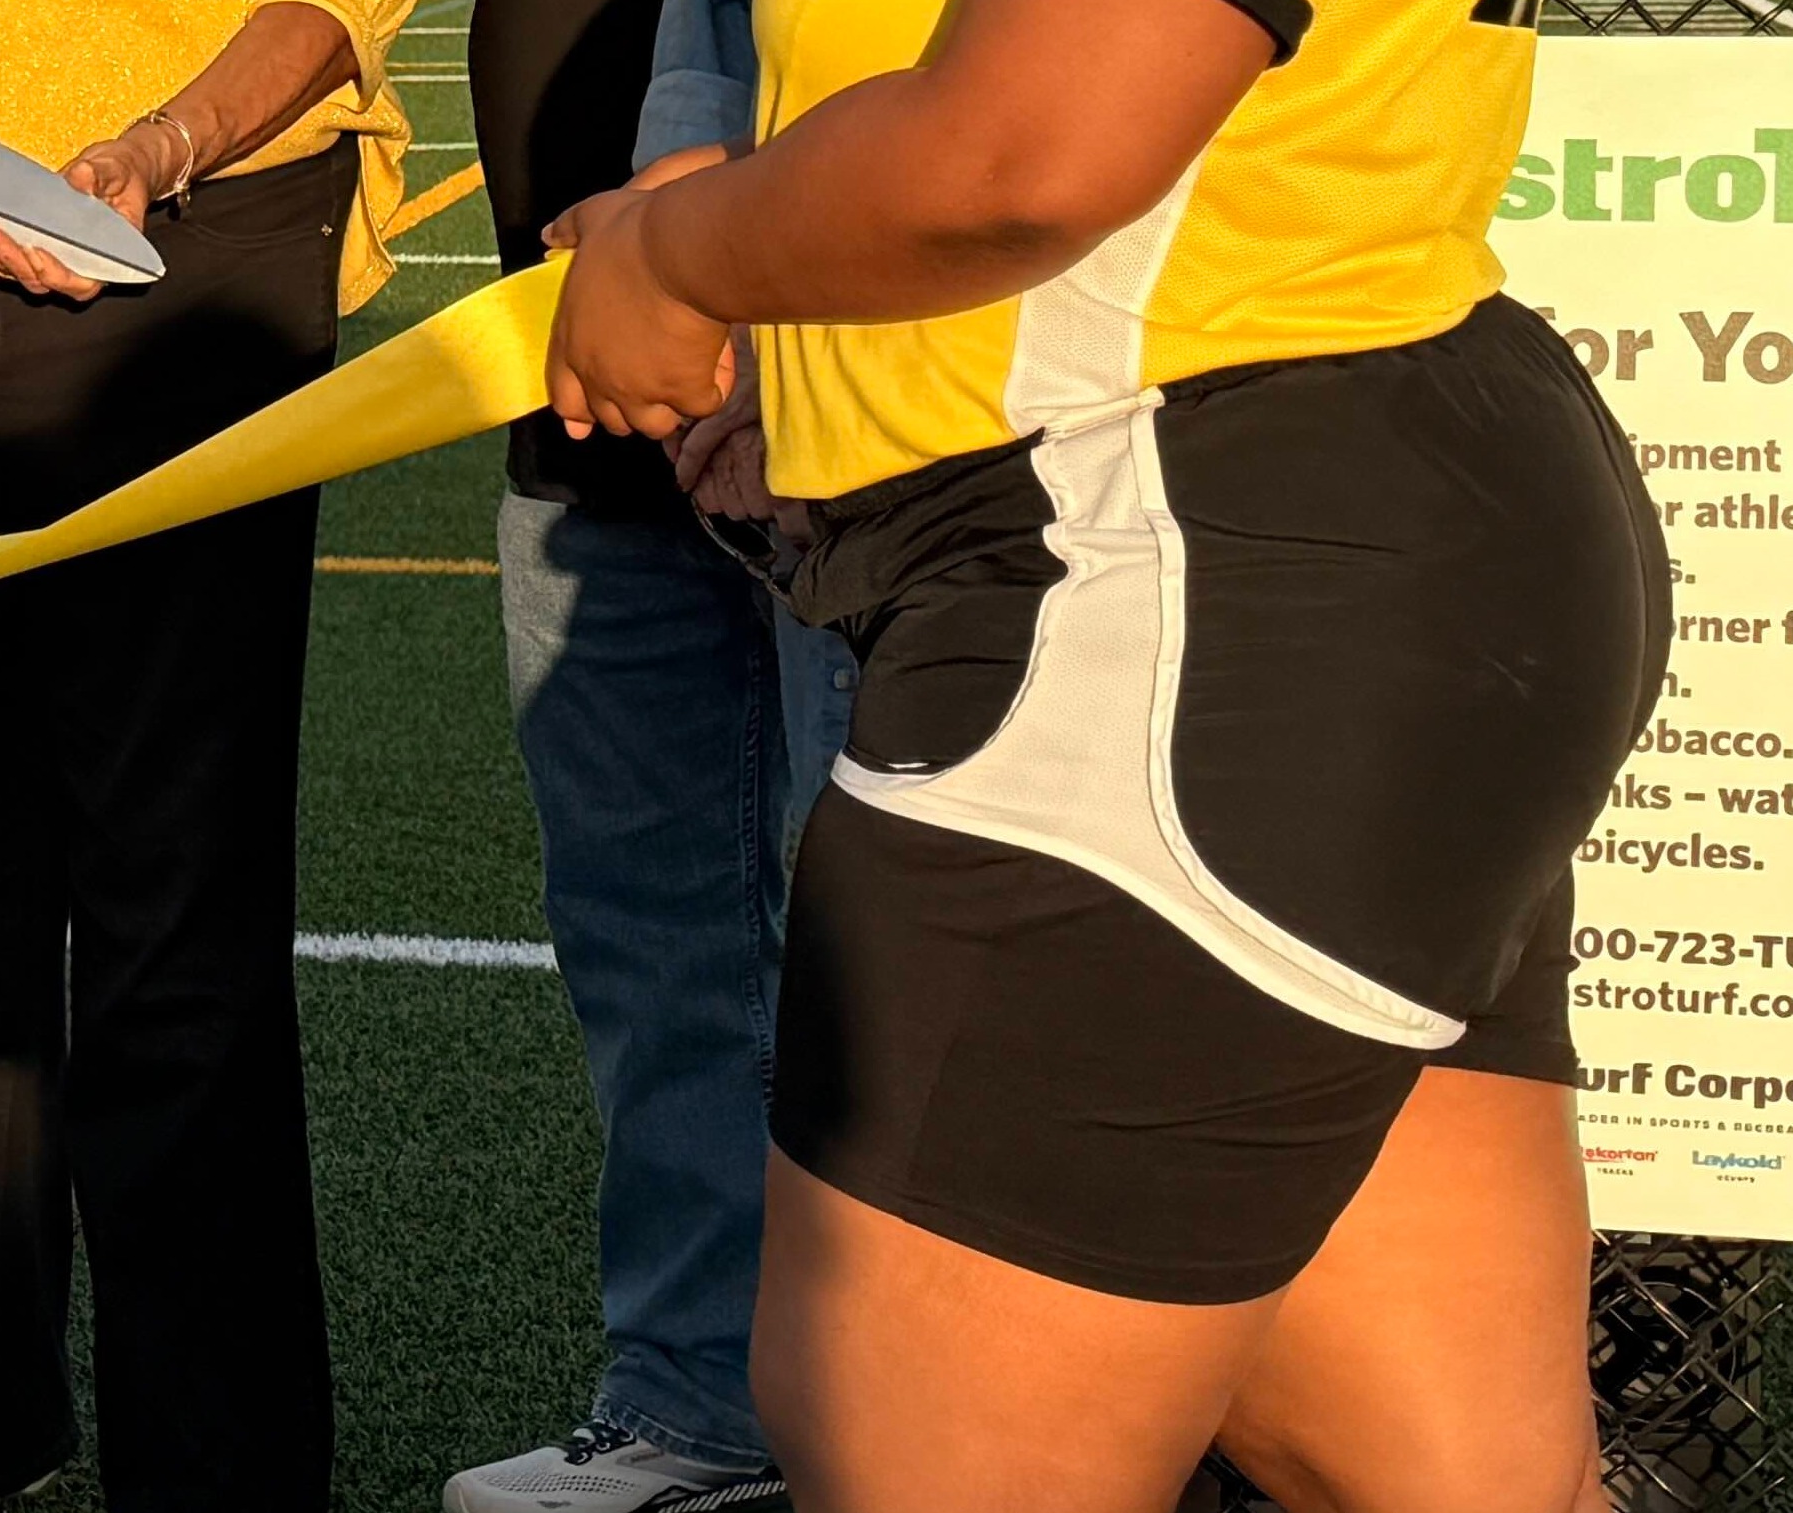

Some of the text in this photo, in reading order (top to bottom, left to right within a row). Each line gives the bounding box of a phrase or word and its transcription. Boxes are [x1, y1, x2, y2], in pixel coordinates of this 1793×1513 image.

[1532, 306, 1793, 384] or Yo
[1672, 615, 1771, 643] rner
[1573, 926, 1793, 969] 00-723-T
[1573, 978, 1793, 1018] stroturf.co
[1665, 1064, 1793, 1109] Corp
[1627, 1116, 1642, 1126] IN
[1650, 1117, 1710, 1130] SPORTS
